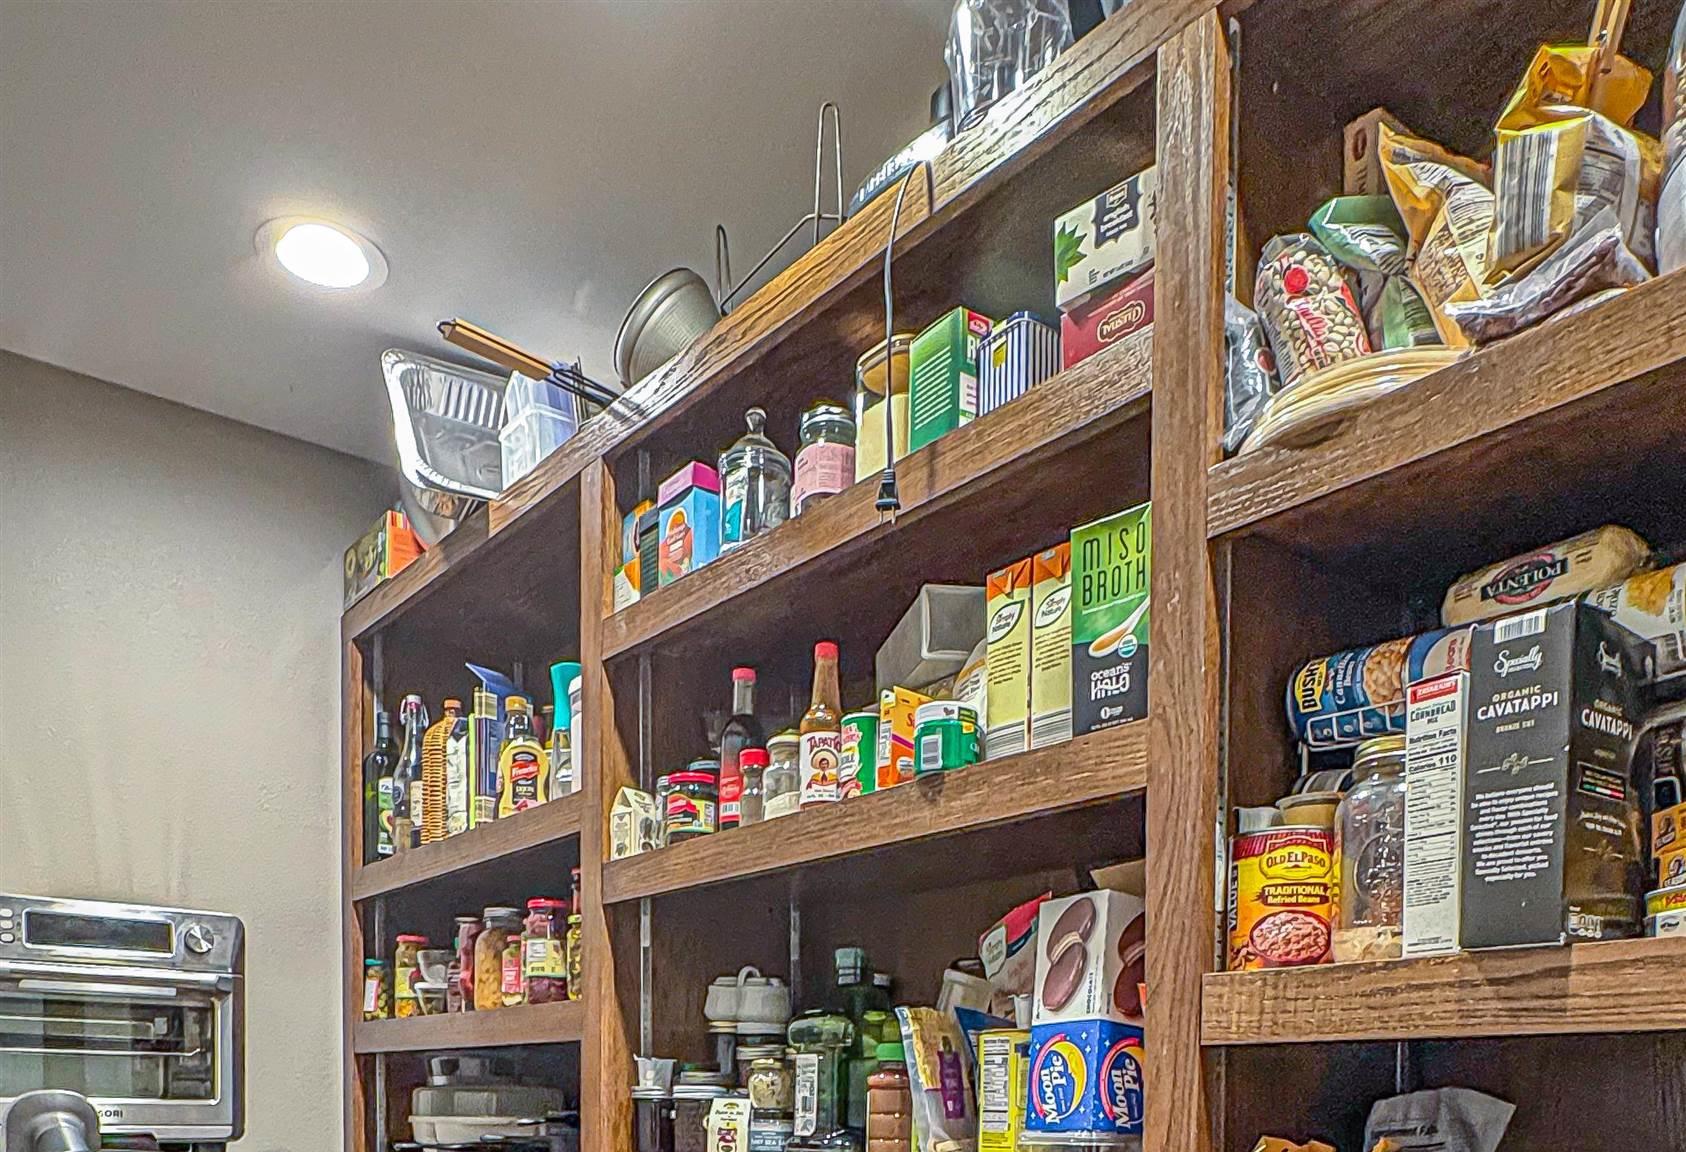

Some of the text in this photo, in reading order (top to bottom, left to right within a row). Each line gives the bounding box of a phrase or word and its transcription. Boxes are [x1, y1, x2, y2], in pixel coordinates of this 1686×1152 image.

[1082, 521, 1146, 573] MISO
[1082, 555, 1146, 606] BROTH
[1486, 561, 1562, 597] POLENTA
[1477, 691, 1558, 721] CAVATAPPI
[1492, 685, 1542, 703] ORGANIC
[1581, 708, 1633, 740] CAVATAPPI
[1439, 754, 1457, 765] 110
[1266, 856, 1286, 868] OLD
[1264, 885, 1326, 895] TRADITIONAL
[1051, 1055, 1067, 1087] Pie
[1123, 1058, 1140, 1094] Pie
[1040, 1067, 1060, 1125] Moon
[1110, 1068, 1131, 1129] Moon
